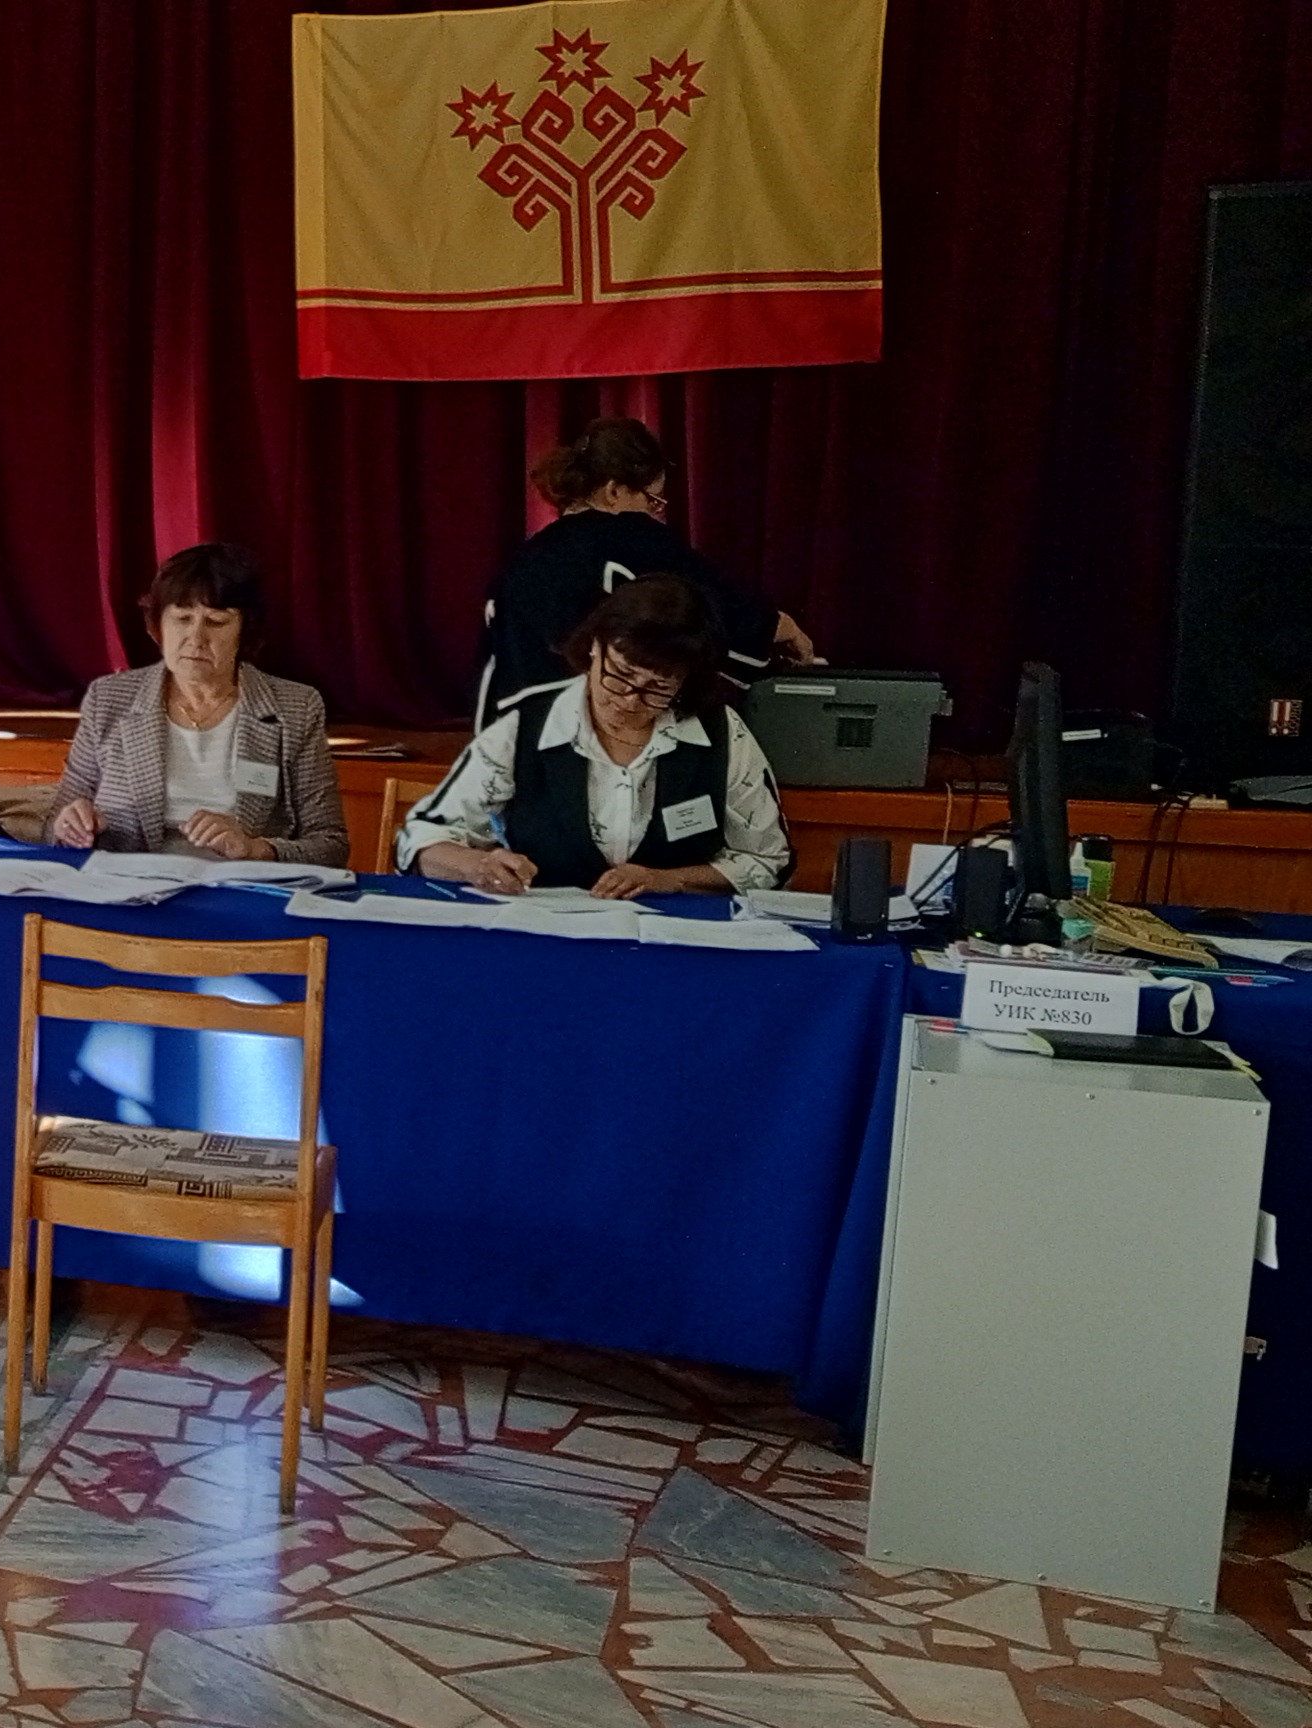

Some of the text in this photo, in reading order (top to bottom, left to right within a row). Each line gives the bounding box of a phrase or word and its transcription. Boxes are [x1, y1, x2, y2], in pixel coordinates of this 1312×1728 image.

[989, 979, 1110, 1003] Председатель
[994, 1003, 1092, 1025] УИК №830
